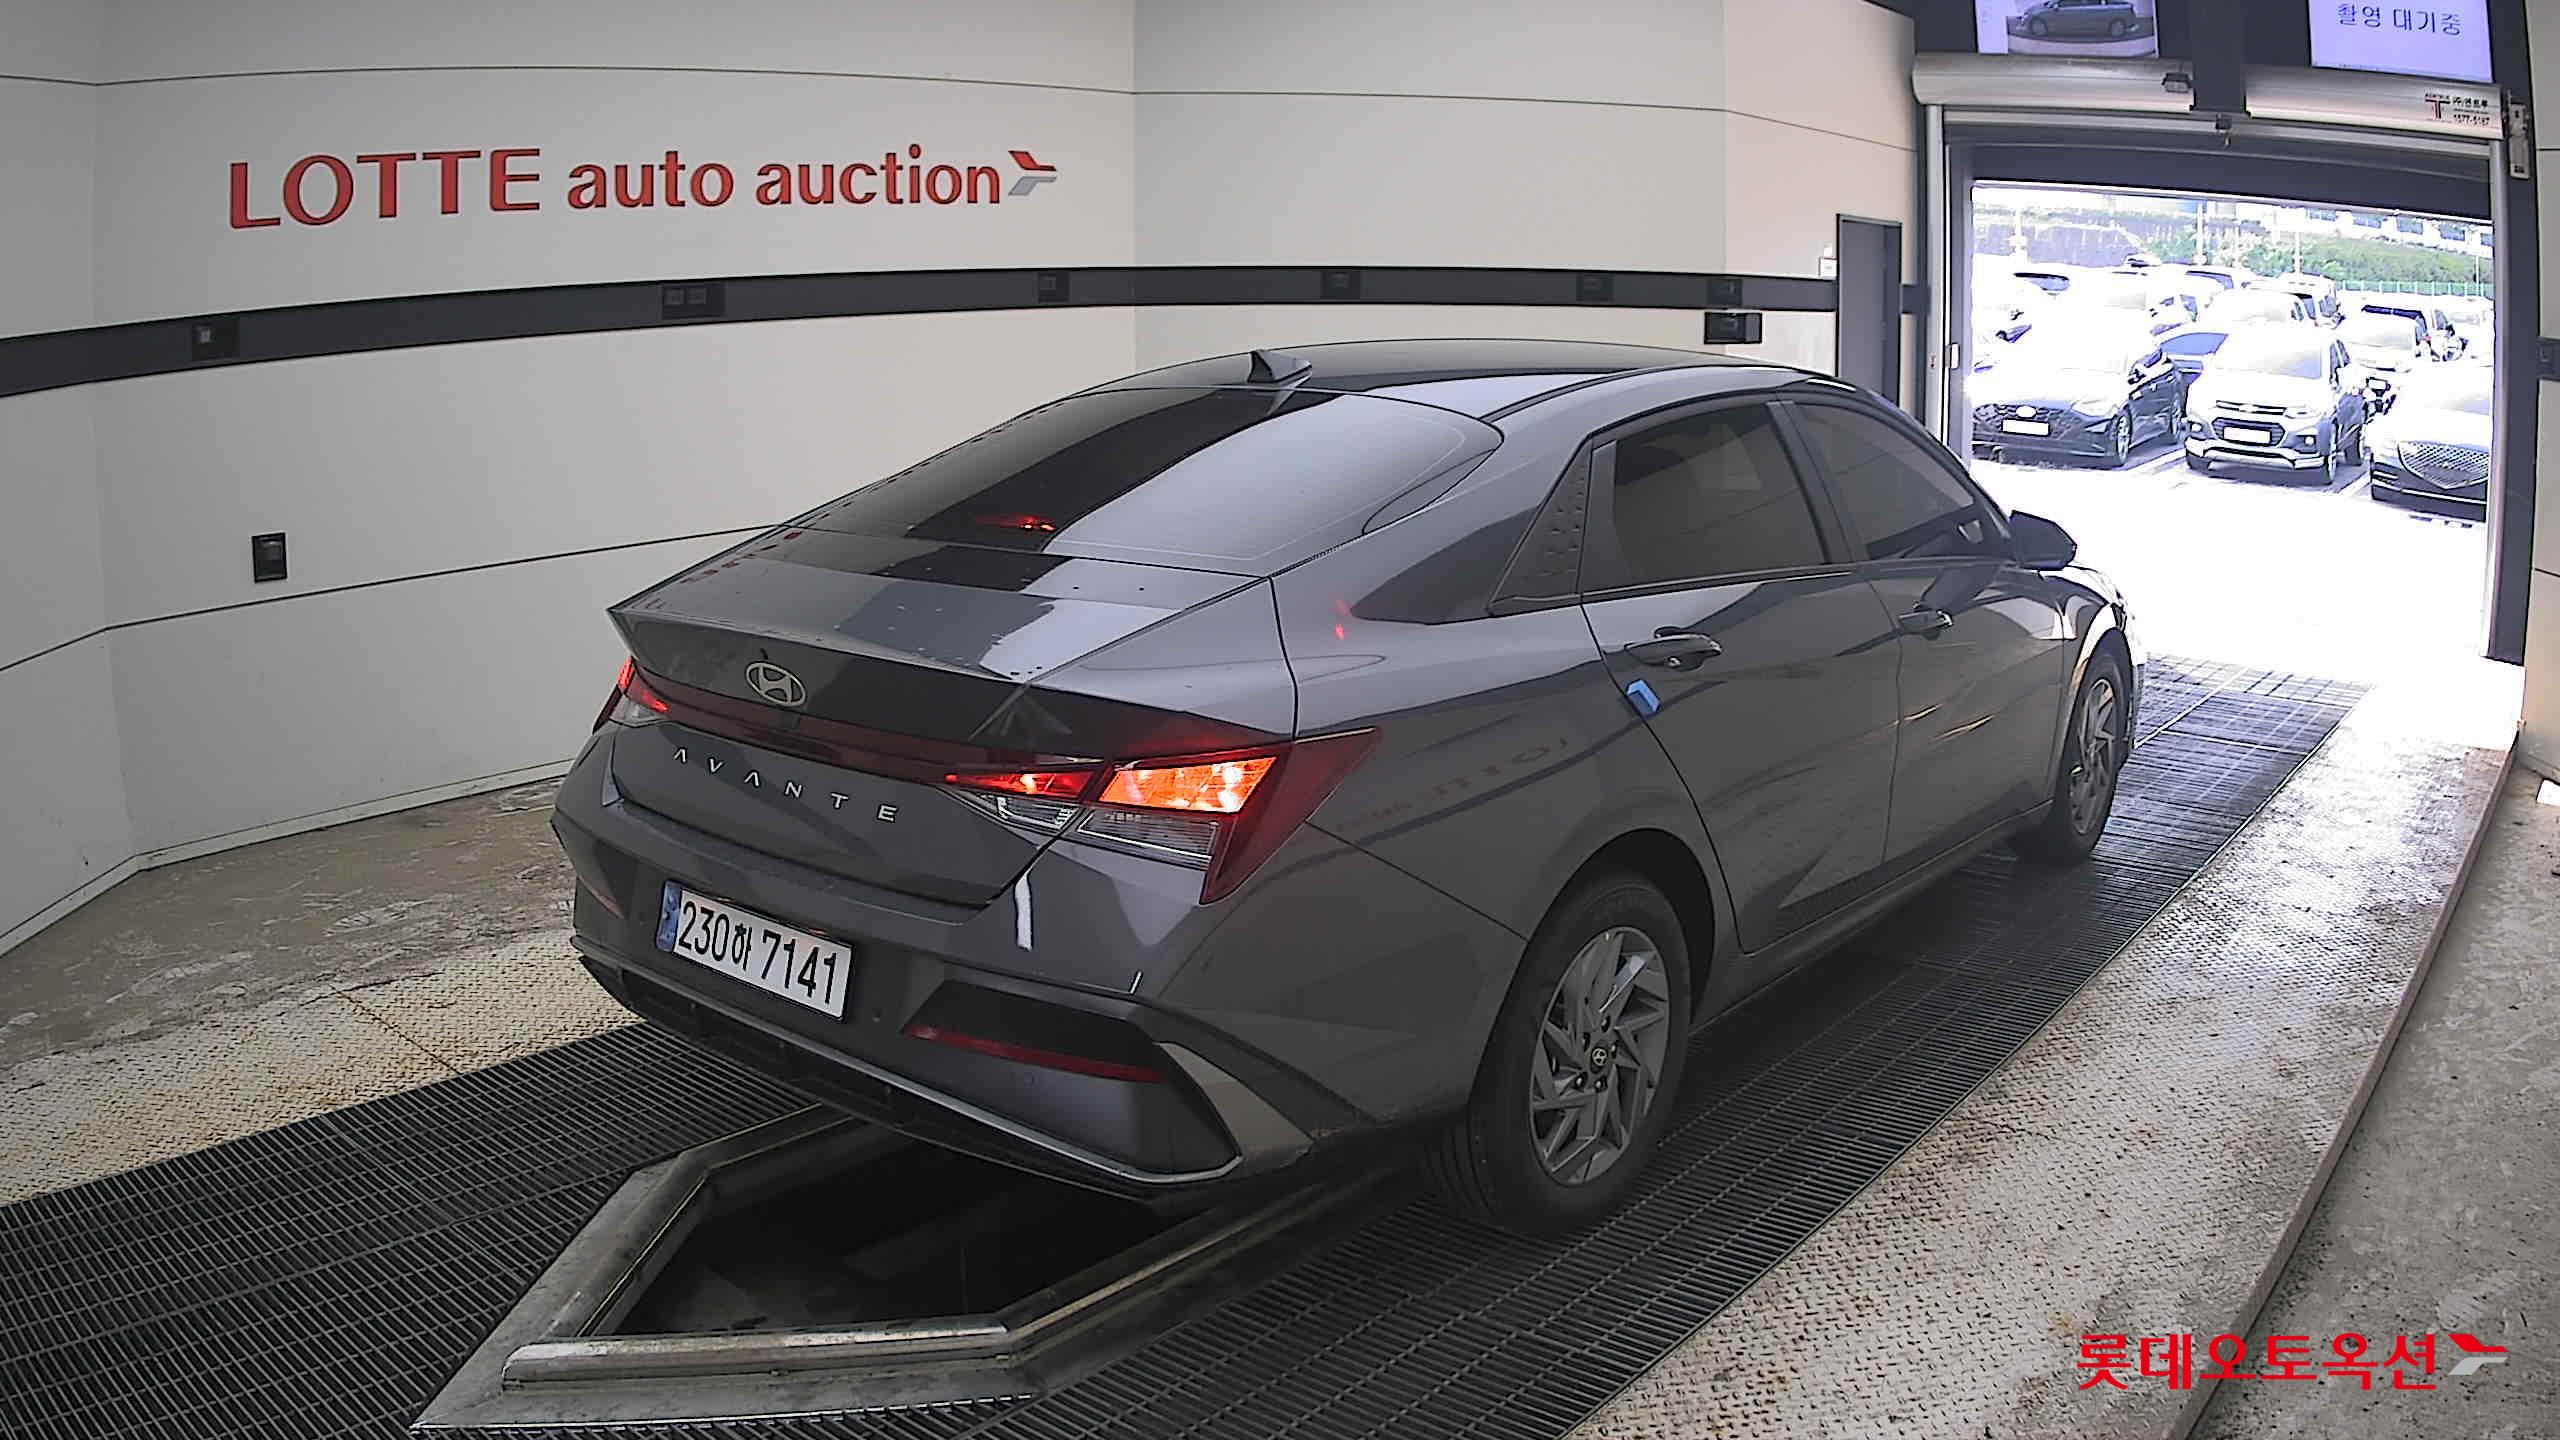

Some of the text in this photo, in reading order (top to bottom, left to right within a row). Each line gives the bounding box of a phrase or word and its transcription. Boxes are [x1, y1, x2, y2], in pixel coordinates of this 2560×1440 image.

[2338, 3, 2461, 36] 촬영 대기중
[229, 144, 1001, 229] LOTTE auto auction
[673, 748, 898, 822] AVANTE
[678, 900, 838, 1005] 230하 7141
